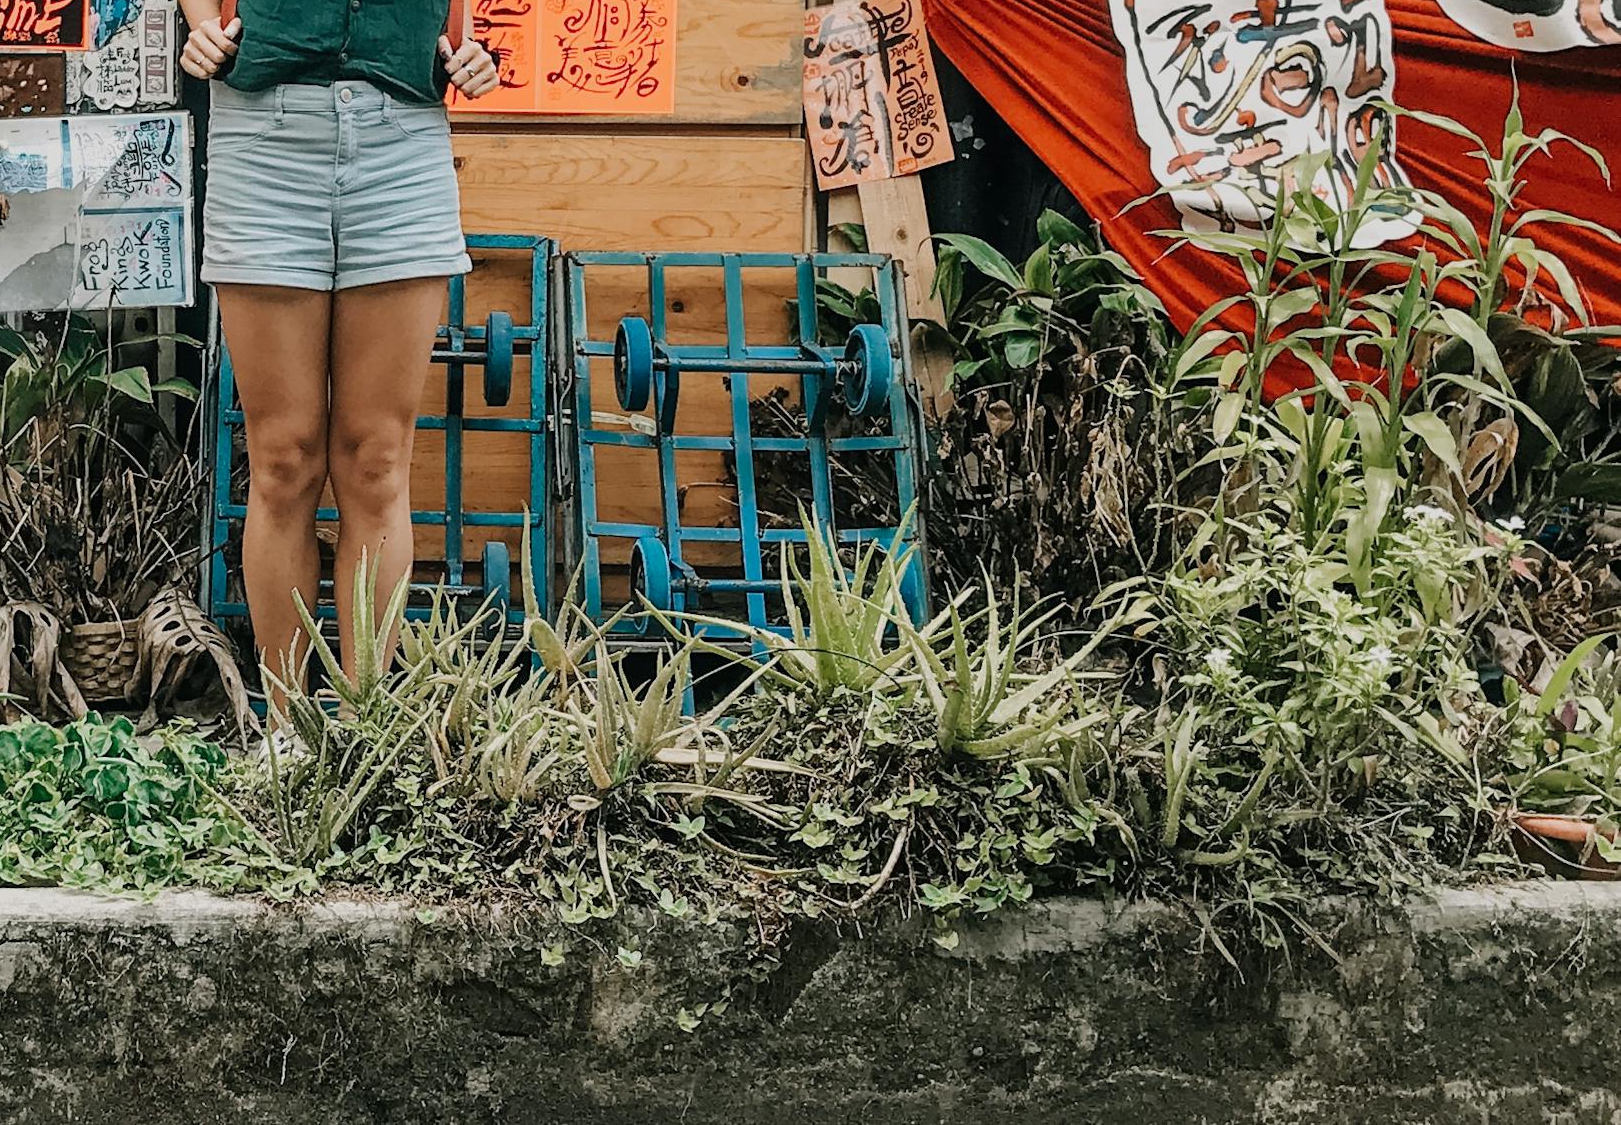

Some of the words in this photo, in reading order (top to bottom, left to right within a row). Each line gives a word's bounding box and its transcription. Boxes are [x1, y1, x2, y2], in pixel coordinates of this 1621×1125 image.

[82, 238, 109, 291] Frog
[110, 236, 133, 291] King
[154, 218, 174, 290] Foundation
